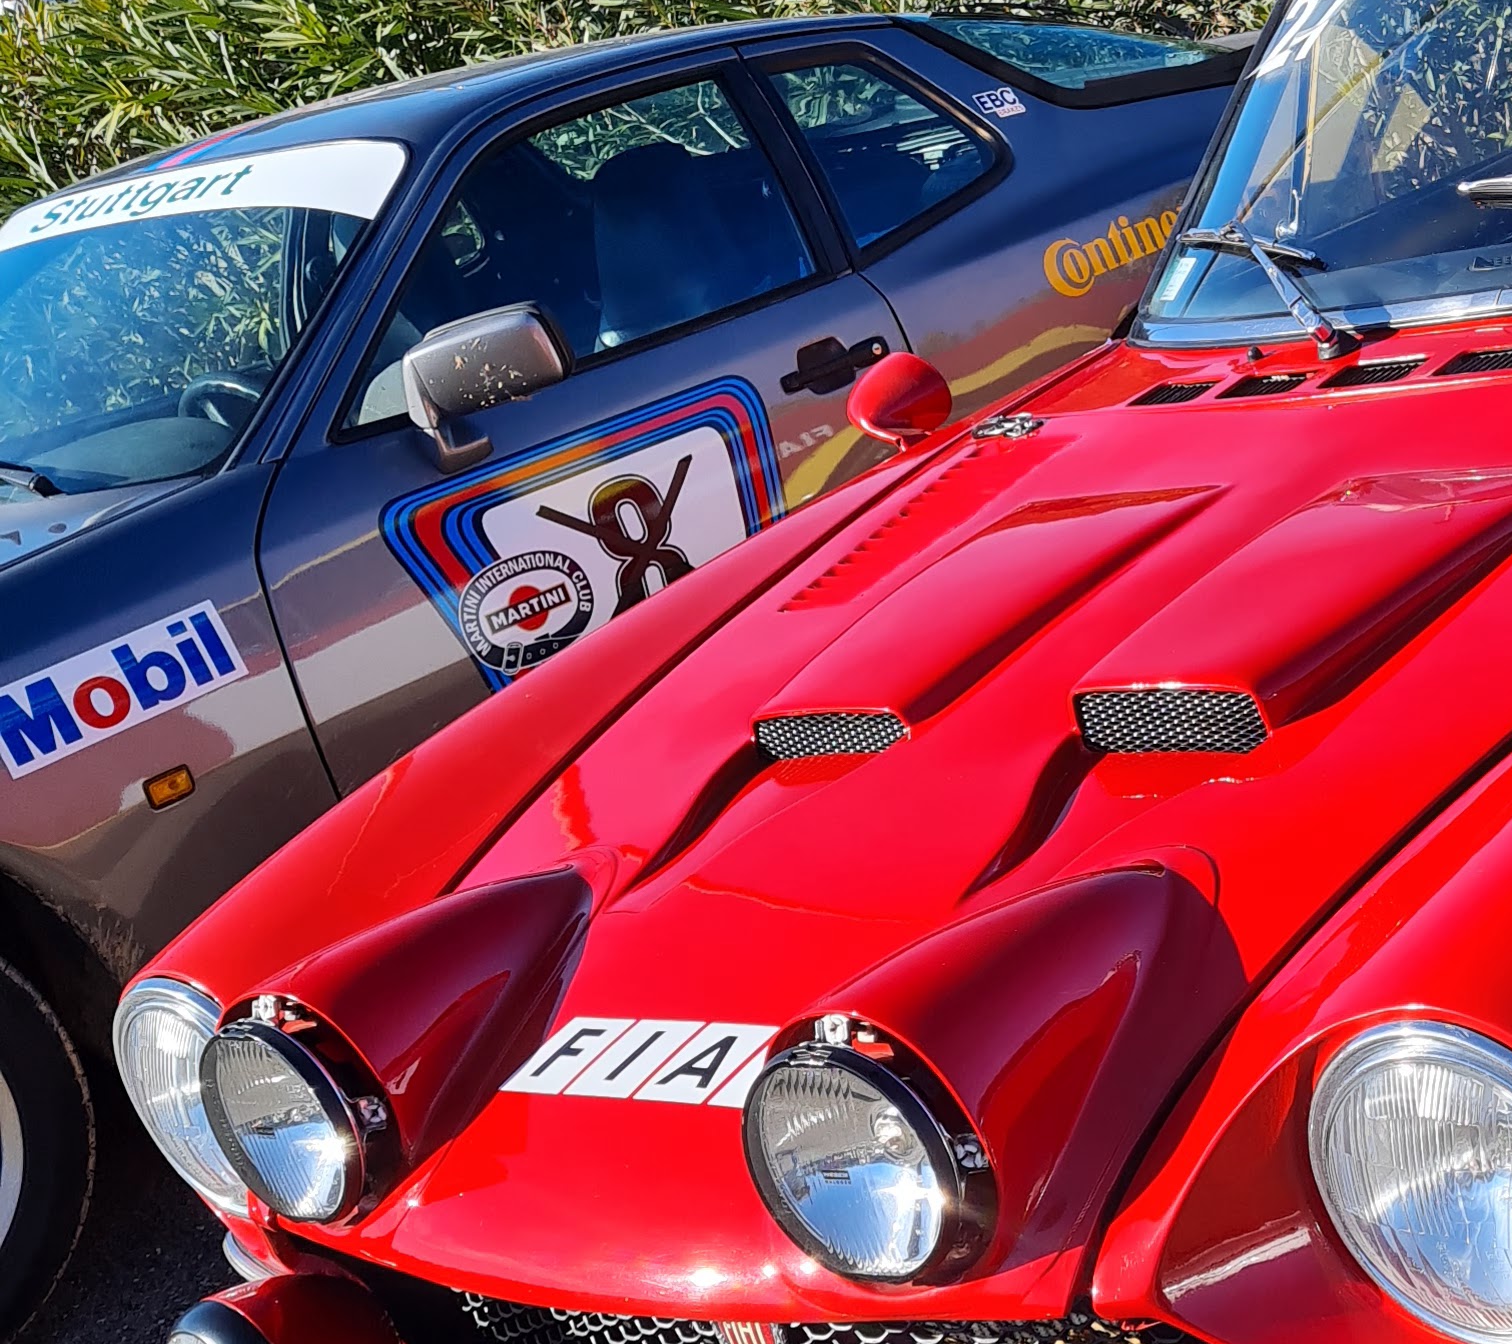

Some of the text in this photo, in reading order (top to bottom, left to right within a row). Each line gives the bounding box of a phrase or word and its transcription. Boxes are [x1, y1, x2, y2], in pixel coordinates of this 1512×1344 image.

[974, 89, 1017, 112] EBC
[29, 163, 255, 234] Stuttgart
[1043, 207, 1182, 298] Contine
[587, 473, 692, 622] 8
[463, 552, 592, 657] MARTINI INTERNATIONAL CLUB
[490, 587, 566, 630] MARTINI
[0, 610, 237, 768] Mobil
[529, 1027, 739, 1089] FIA
